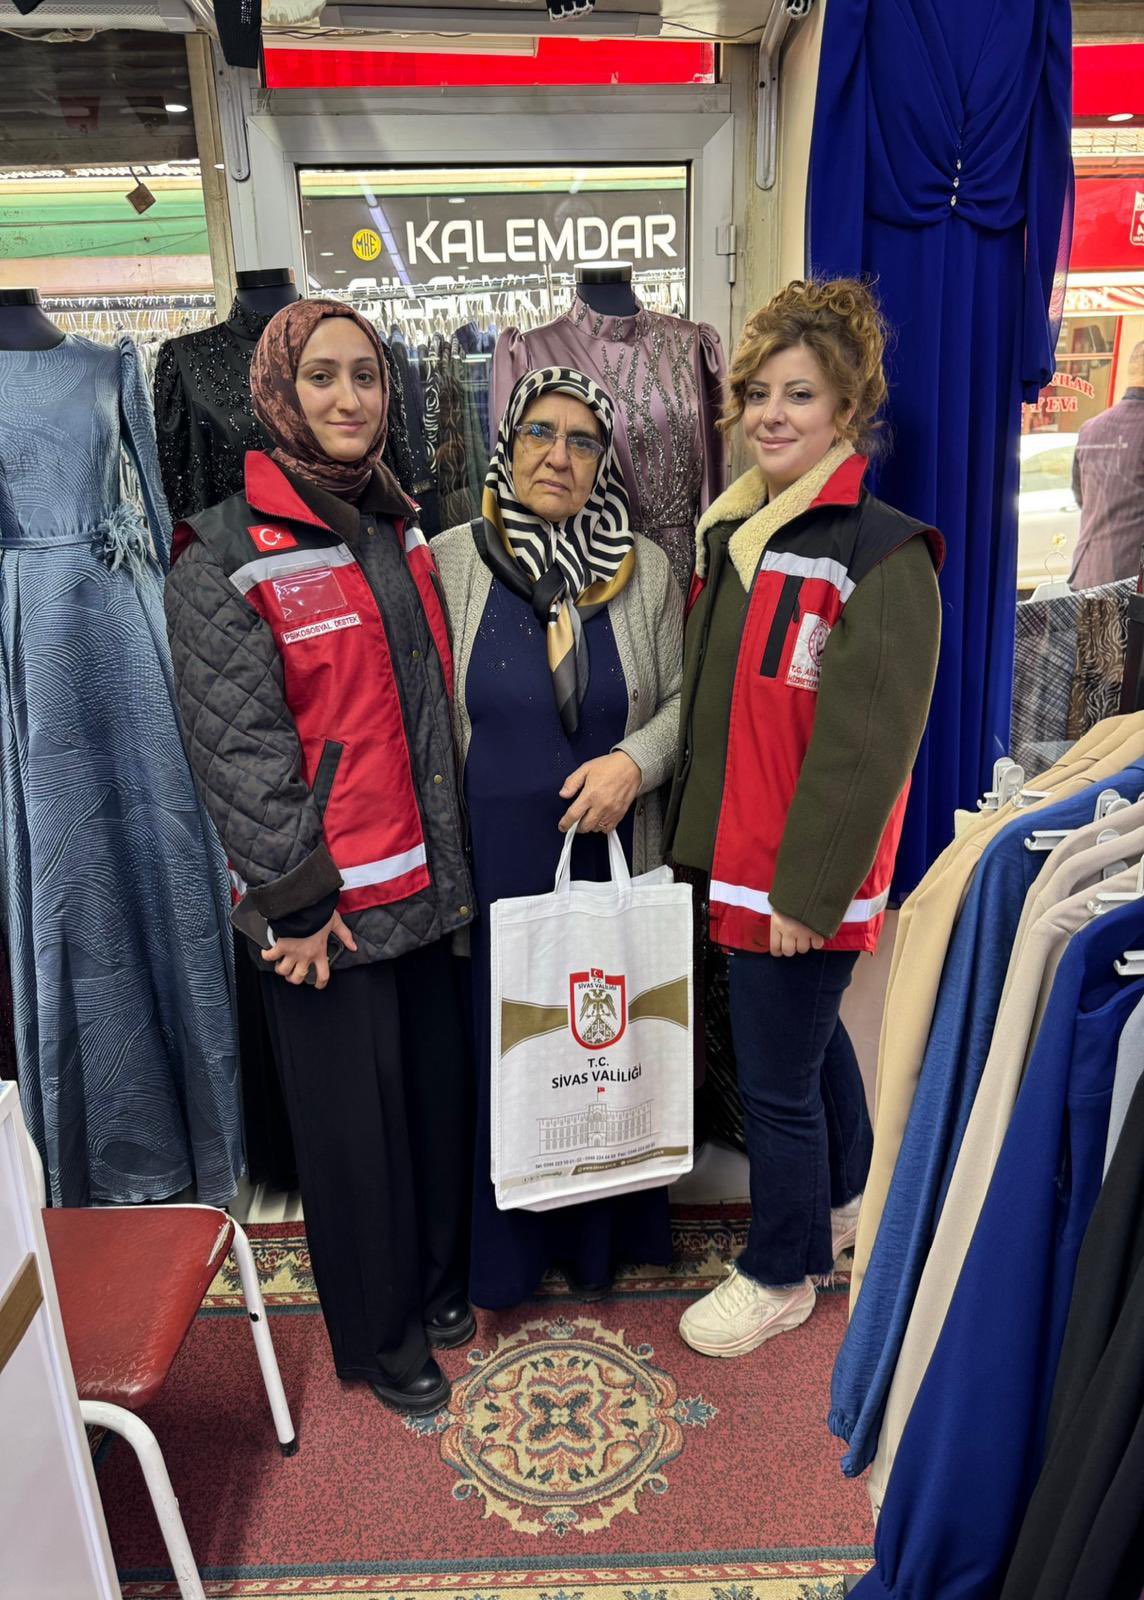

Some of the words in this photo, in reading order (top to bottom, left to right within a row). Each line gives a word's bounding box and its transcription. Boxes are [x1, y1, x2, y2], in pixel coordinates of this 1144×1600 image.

[406, 213, 679, 265] KALEMDAR
[334, 615, 359, 628] DESTEK
[587, 1056, 610, 1068] T.C.
[551, 1071, 589, 1089] SİVAS
[591, 1063, 642, 1083] VALİLİĞİ
